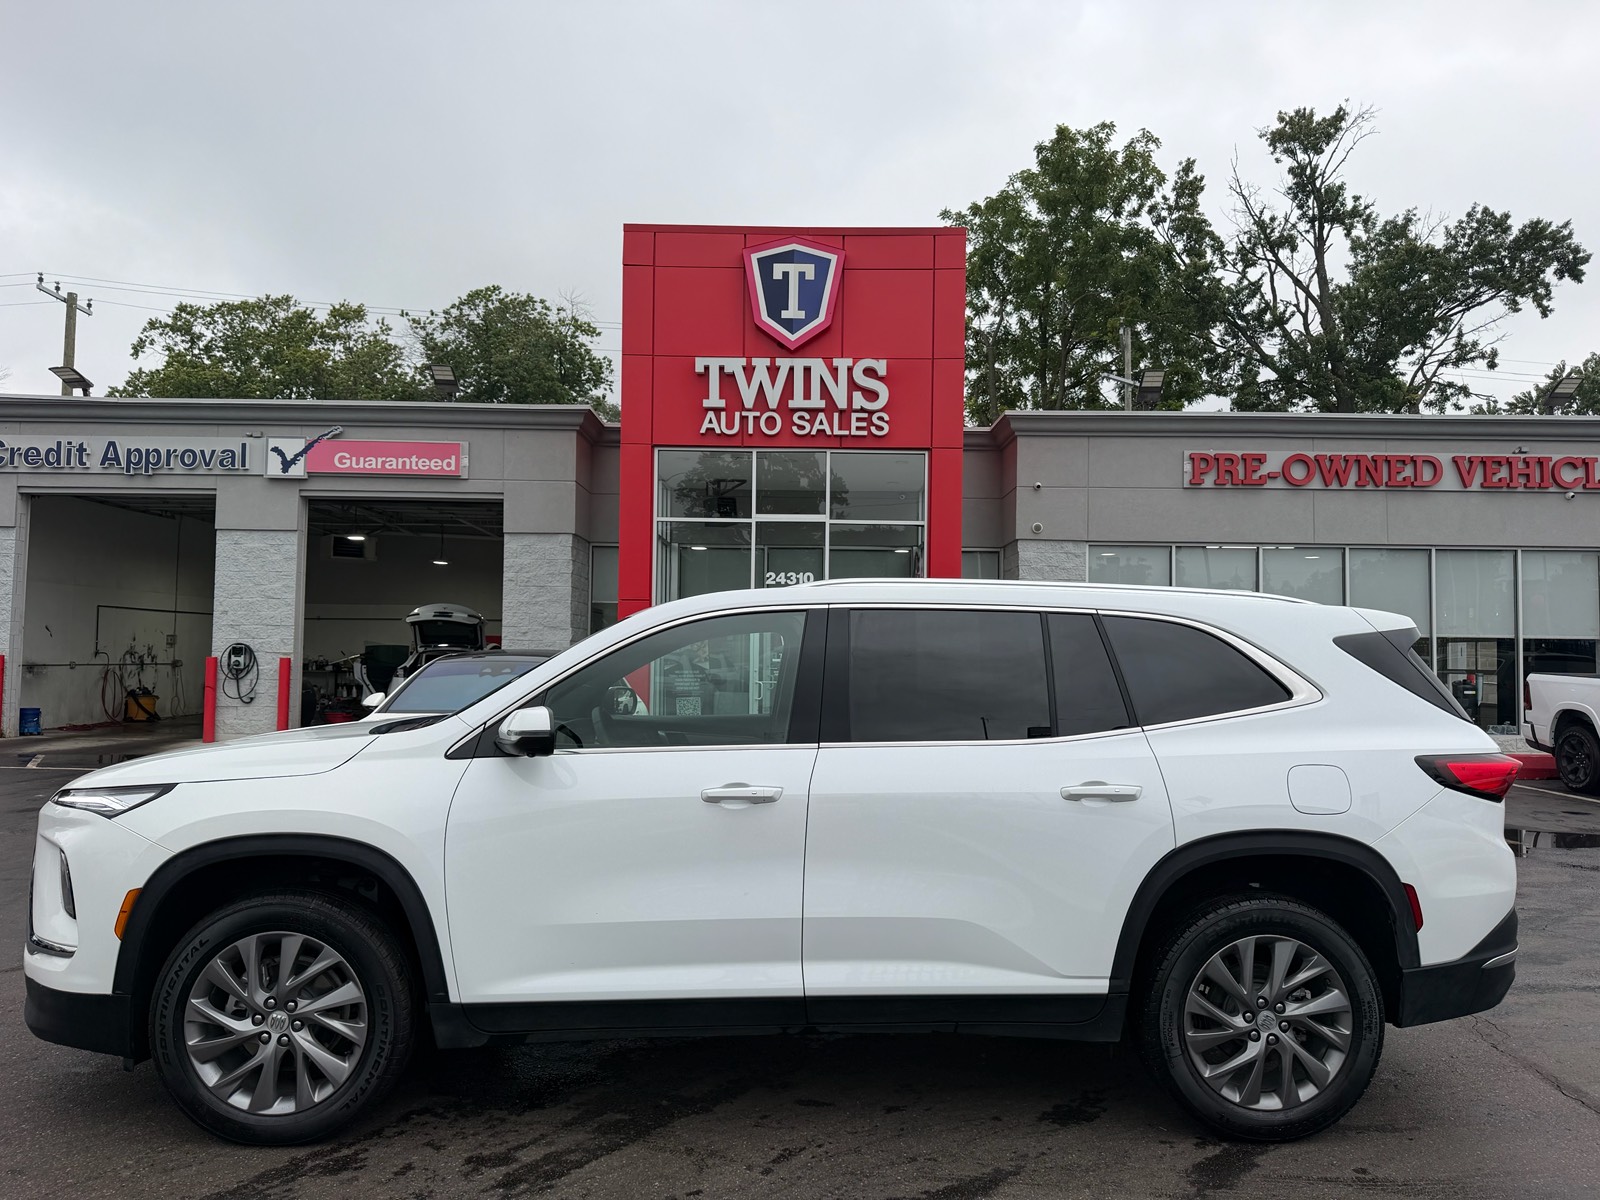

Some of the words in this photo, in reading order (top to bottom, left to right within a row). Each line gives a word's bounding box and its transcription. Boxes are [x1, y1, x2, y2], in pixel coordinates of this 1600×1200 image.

[773, 263, 815, 319] T
[695, 357, 890, 410] TWINS
[700, 411, 782, 436] AUTO
[792, 411, 890, 437] SALES
[100, 440, 248, 476] Approval
[333, 453, 456, 472] Guaranteed
[1189, 452, 1443, 487] PRE-OWNED
[1452, 455, 1600, 489] VEHICL
[765, 571, 814, 585] 24310
[158, 938, 210, 1064] CONTINENTAL
[338, 983, 390, 1111] CONTINENTAL
